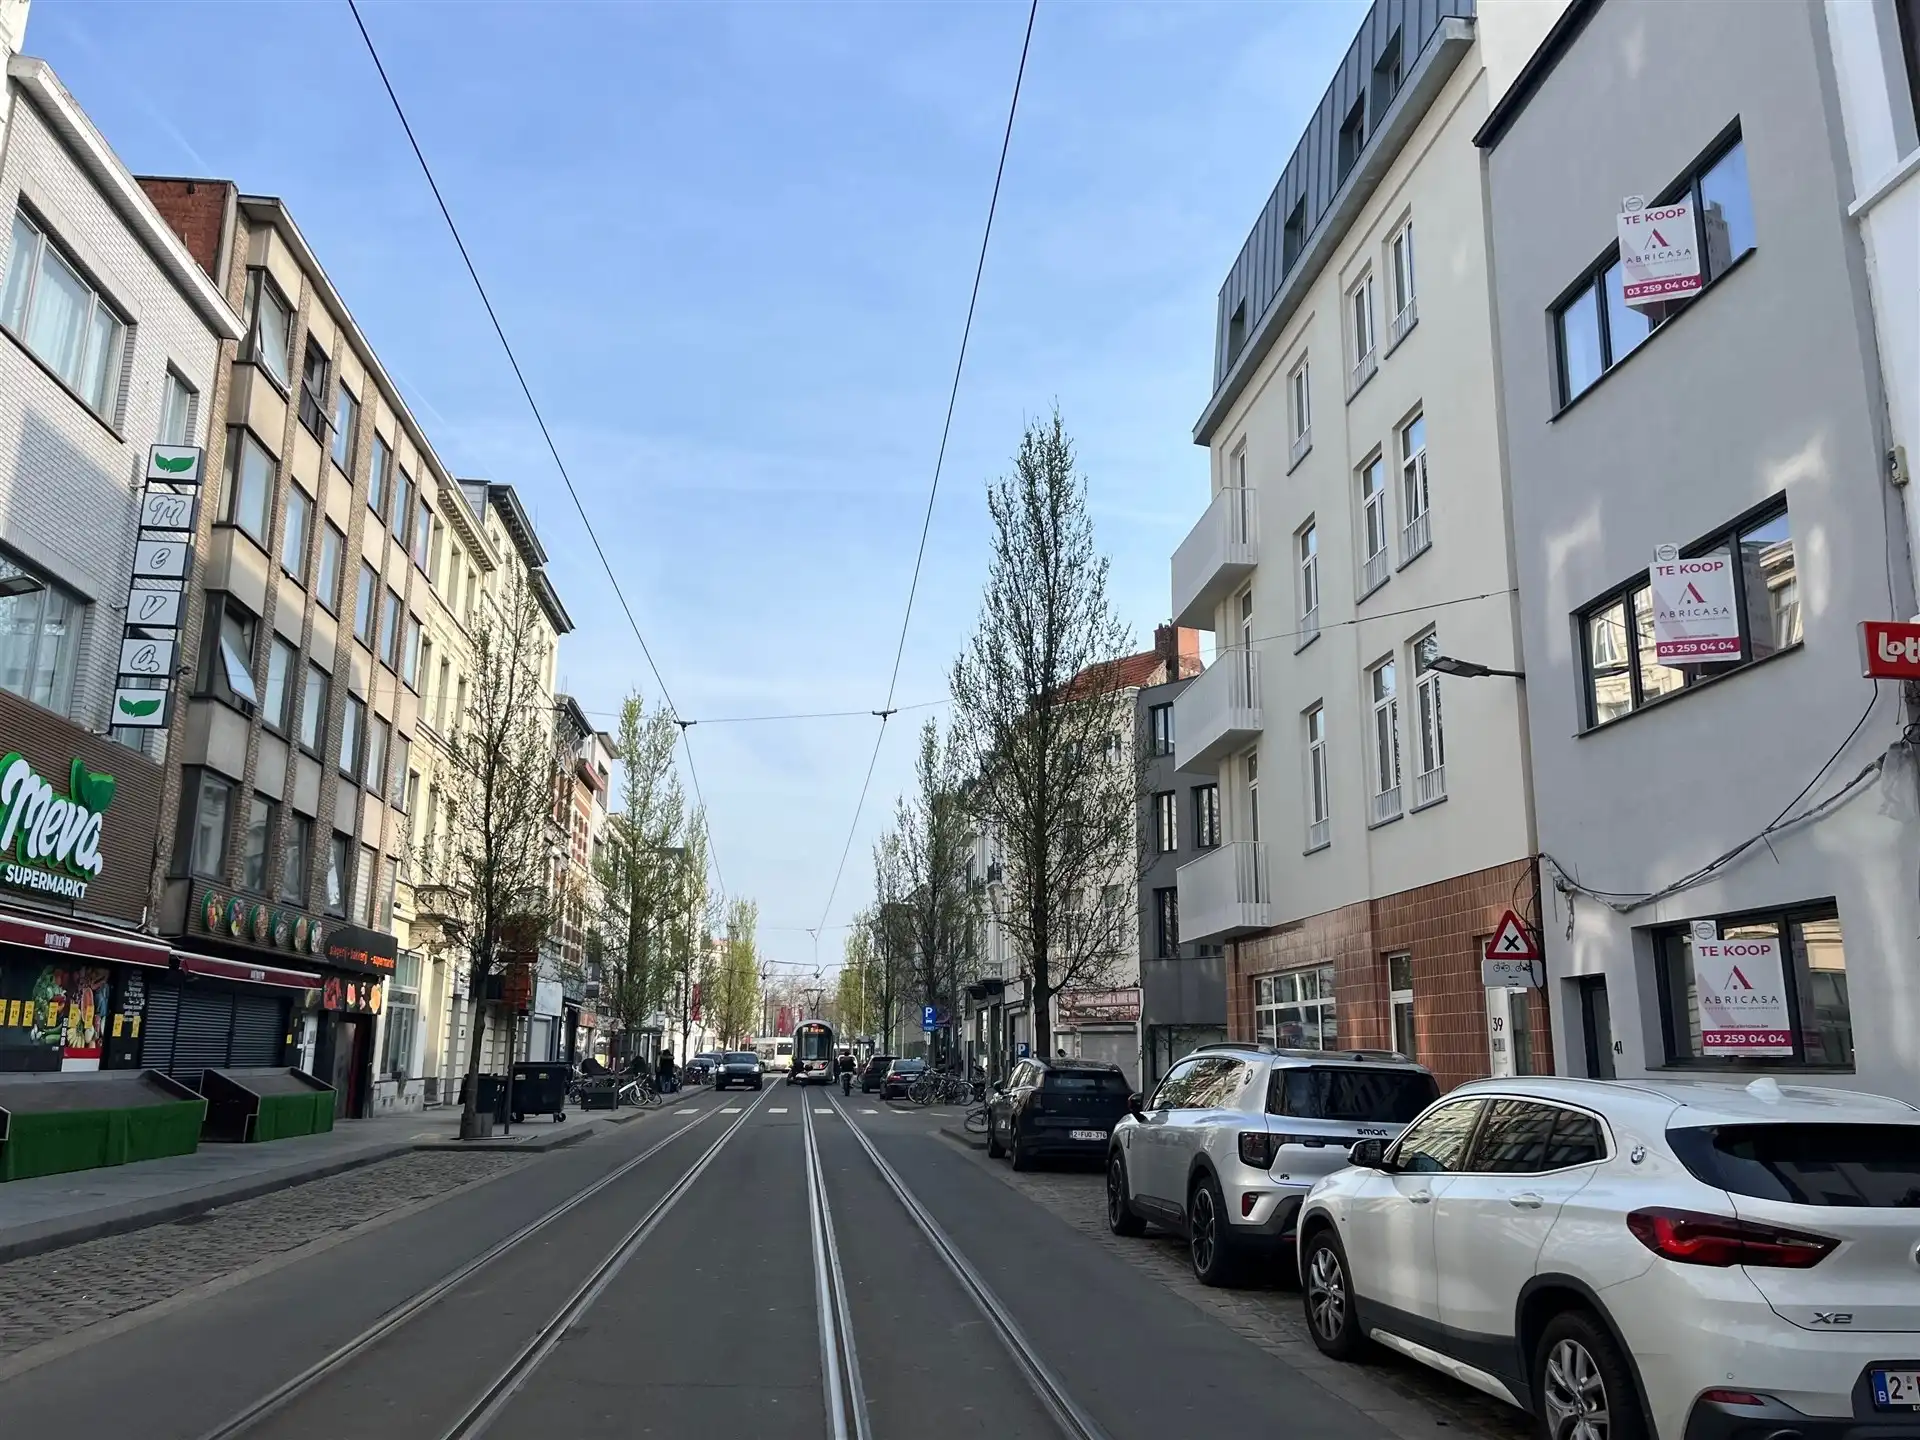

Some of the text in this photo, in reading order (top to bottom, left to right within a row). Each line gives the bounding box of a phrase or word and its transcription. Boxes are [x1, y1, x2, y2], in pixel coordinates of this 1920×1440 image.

[1623, 208, 1686, 225] TE KOOP
[1626, 248, 1691, 264] ABRICASA
[1627, 280, 1696, 296] 03 259 04 04
[1656, 561, 1724, 576] TE KOOP
[1659, 607, 1729, 619] ABRICASA
[1660, 641, 1734, 654] 03 259 04 04
[5, 864, 88, 899] SUPERMARKT
[1699, 944, 1771, 957] TE KOOP
[1704, 995, 1779, 1004] ABRICASA
[925, 1006, 933, 1018] P
[1492, 1017, 1503, 1032] 39
[1706, 1034, 1785, 1044] 03 259 04 04
[1017, 1043, 1026, 1056] P
[1614, 1040, 1623, 1055] 41
[1356, 1128, 1388, 1137] smart
[1809, 1312, 1853, 1324] X2
[1878, 1390, 1887, 1402] B
